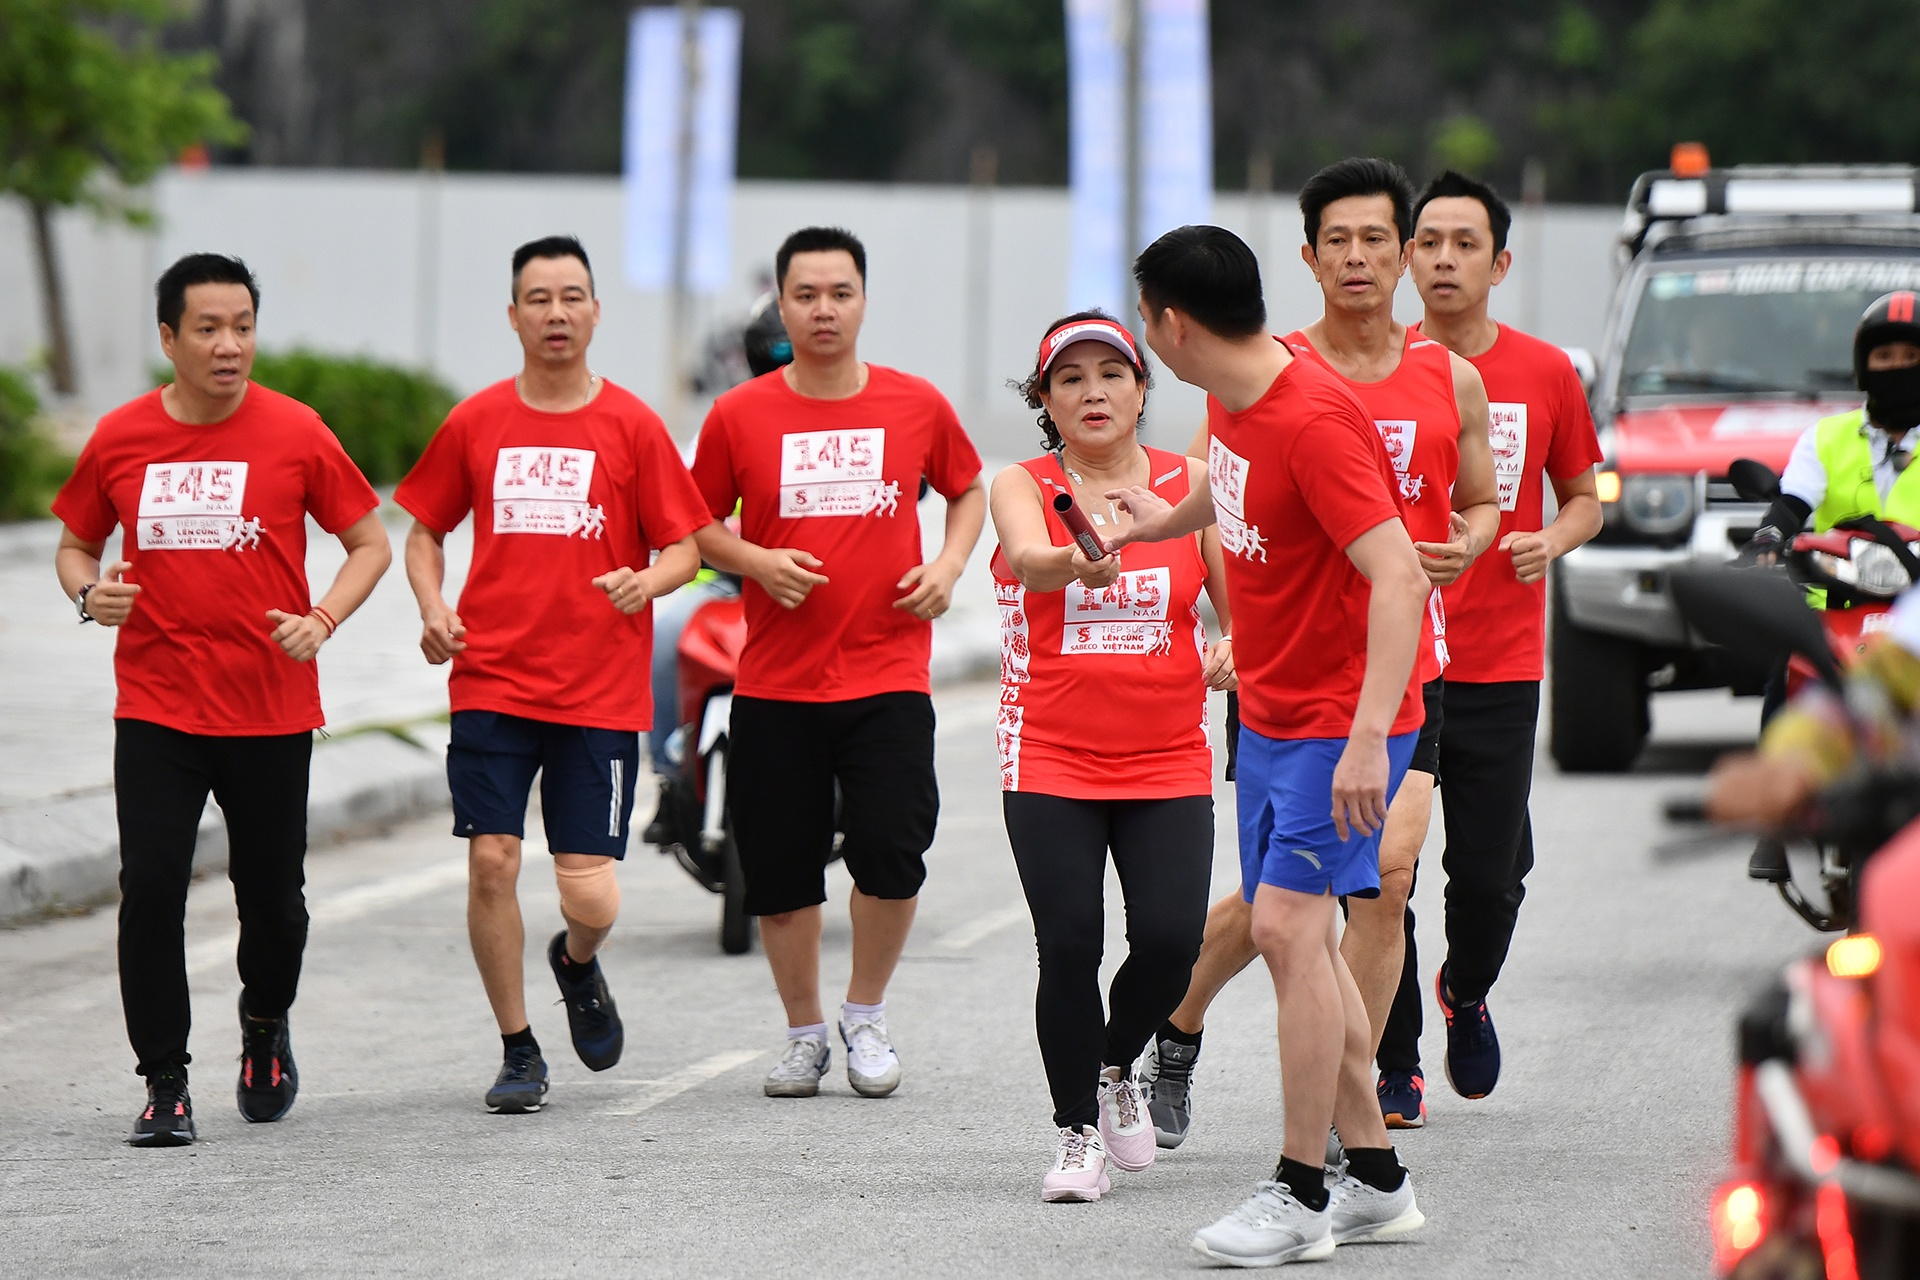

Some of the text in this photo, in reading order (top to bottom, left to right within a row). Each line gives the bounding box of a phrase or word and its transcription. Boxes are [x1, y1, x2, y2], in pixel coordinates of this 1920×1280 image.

[794, 434, 873, 471] 145
[504, 452, 580, 487] 145
[1495, 461, 1518, 472] ĂM
[152, 466, 233, 503] 145
[1498, 483, 1513, 491] NG
[1101, 624, 1145, 633] TIẾP SỨC
[1102, 633, 1144, 641] LÊN CÙNG
[1070, 643, 1097, 651] SABECO
[1102, 643, 1122, 652] VIỆT
